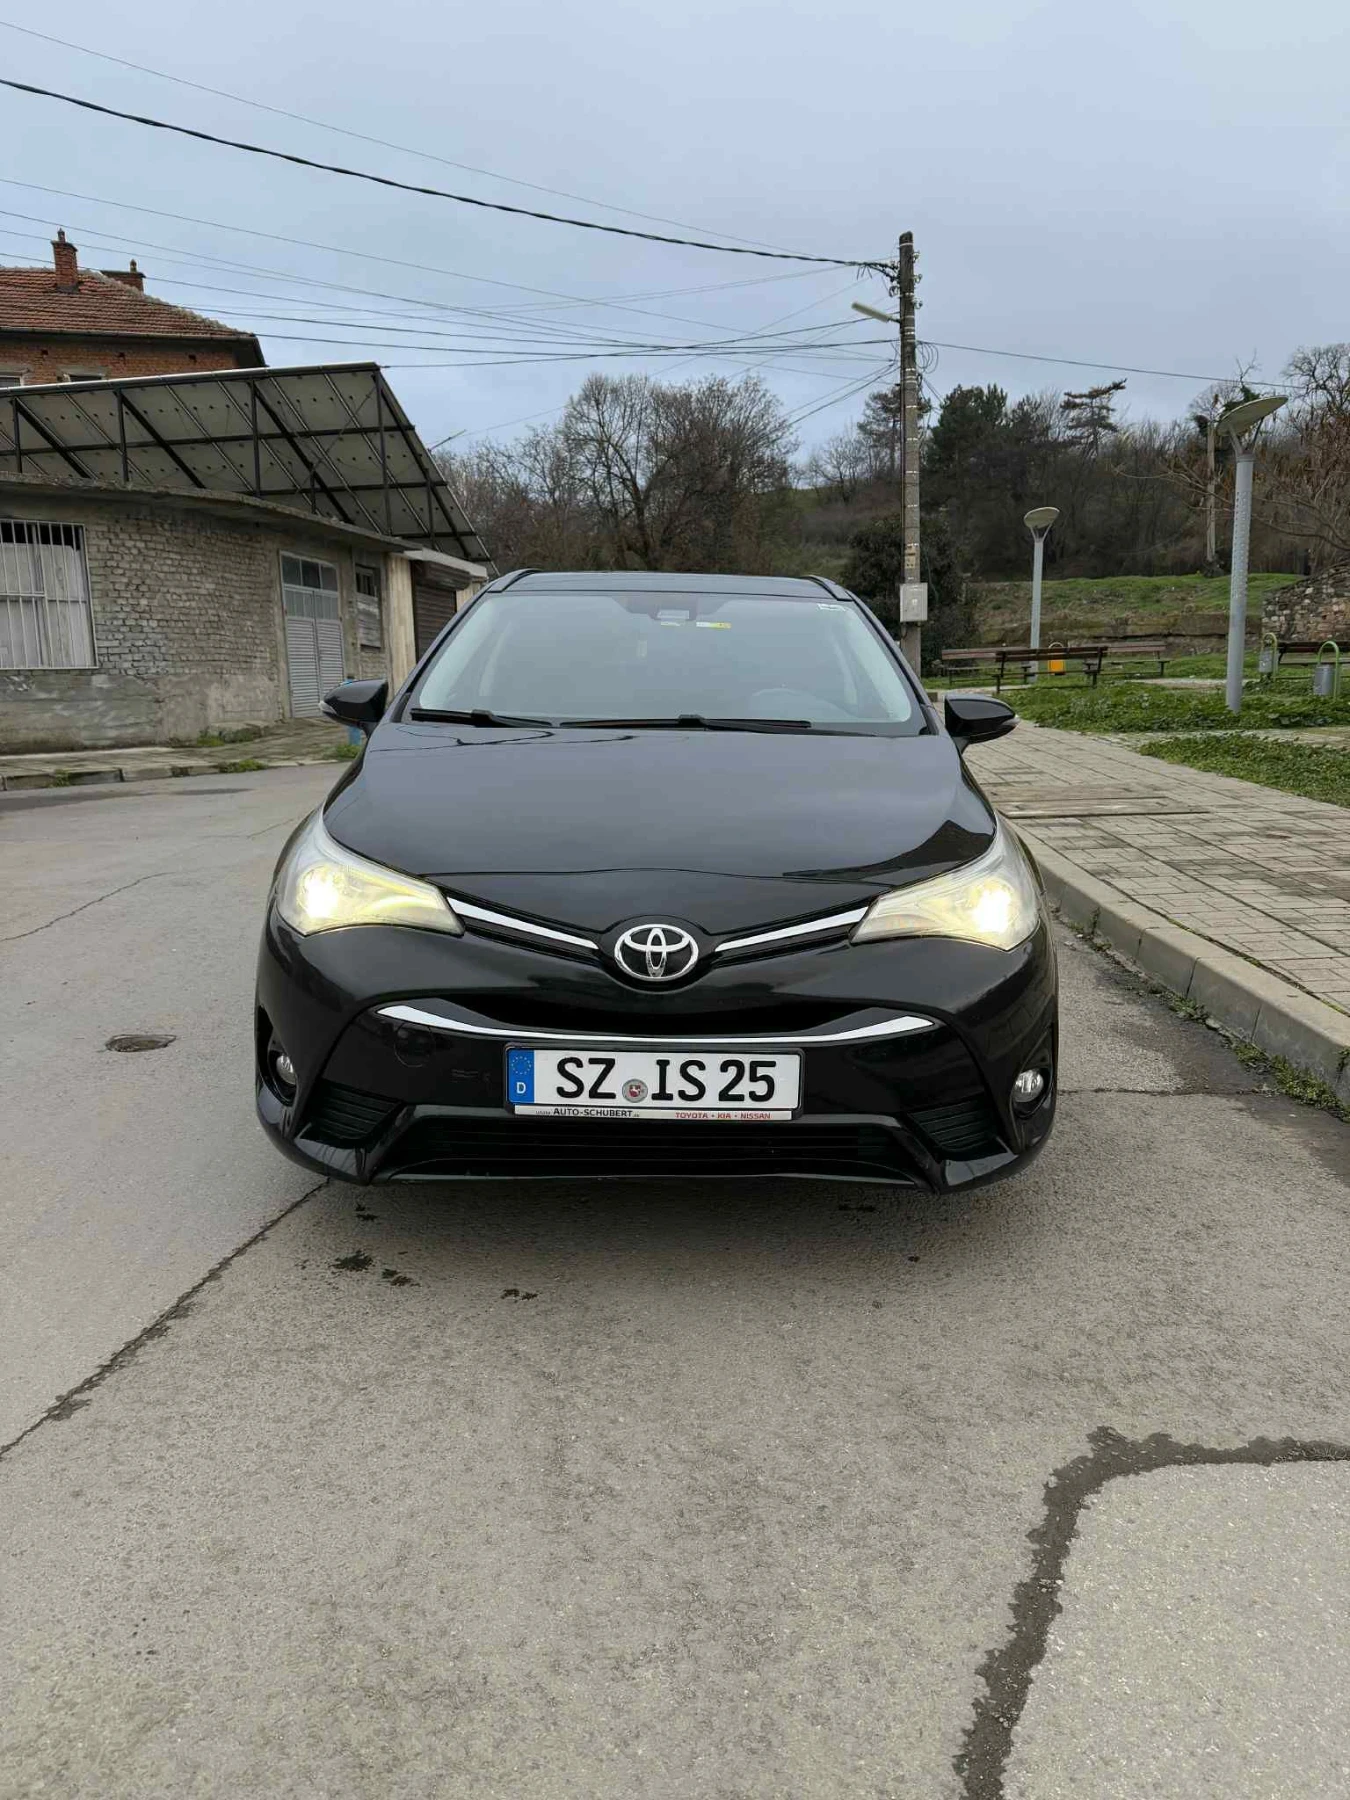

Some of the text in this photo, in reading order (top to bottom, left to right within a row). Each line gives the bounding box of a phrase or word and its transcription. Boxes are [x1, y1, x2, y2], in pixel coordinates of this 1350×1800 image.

[556, 1056, 777, 1102] SZ IS 25
[516, 1081, 526, 1094] D
[740, 1112, 771, 1120] NISSAN
